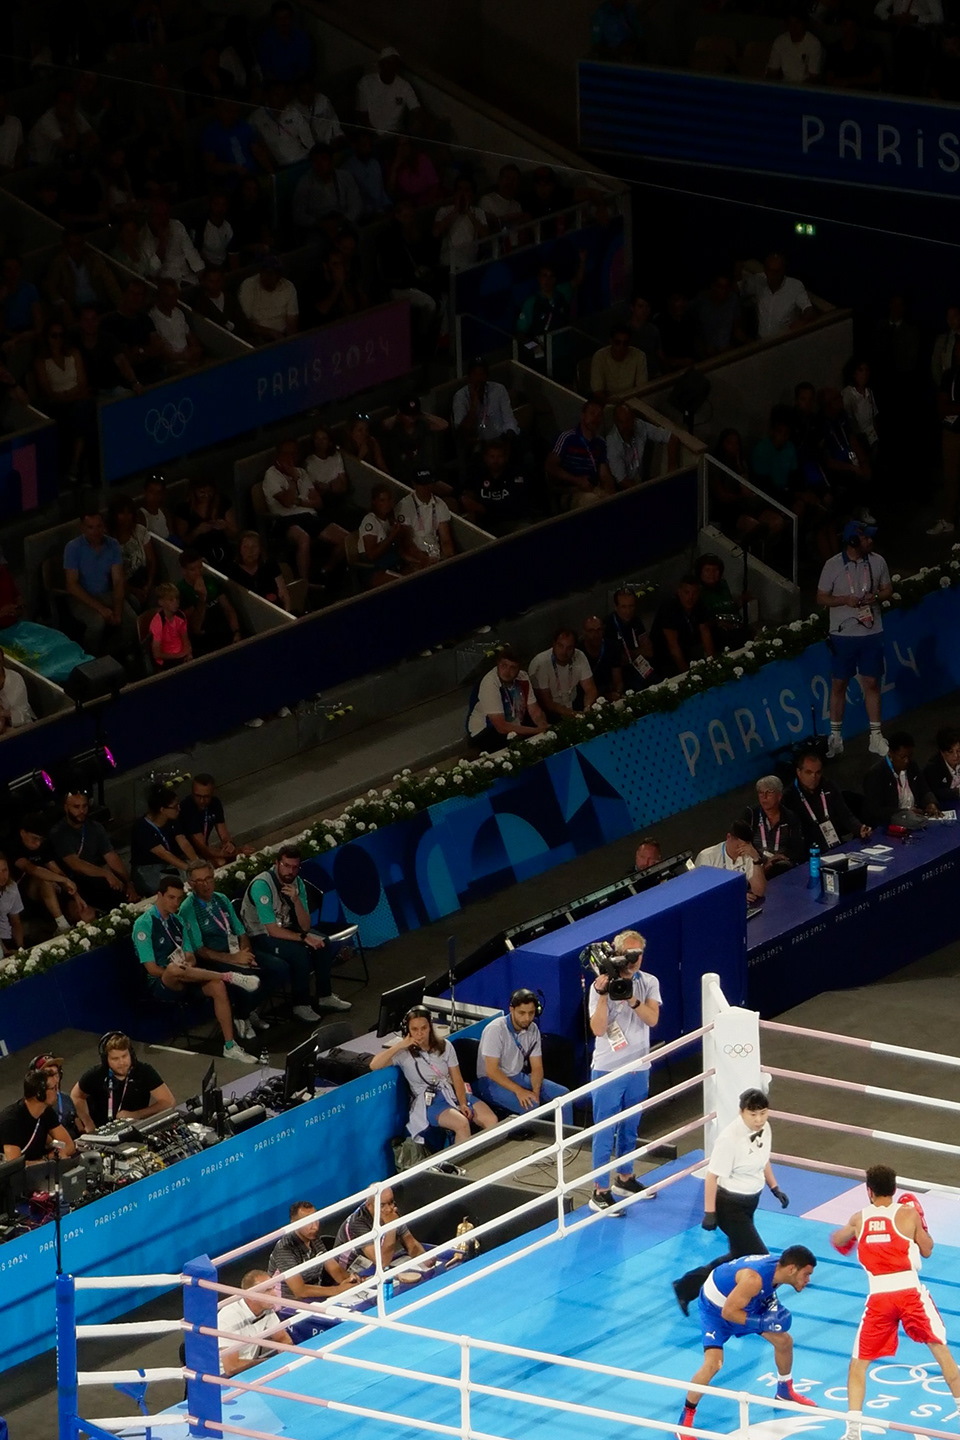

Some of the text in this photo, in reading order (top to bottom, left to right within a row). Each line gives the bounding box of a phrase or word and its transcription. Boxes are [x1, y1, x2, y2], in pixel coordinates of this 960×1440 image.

[481, 488, 510, 500] USA
[378, 1079, 397, 1094] 2024
[327, 1103, 346, 1118] 2024
[276, 1127, 296, 1142] 2024
[224, 1151, 244, 1167] 2024
[171, 1175, 191, 1191] 2024
[117, 1201, 138, 1217] 2024
[868, 1220, 886, 1231] FRA
[39, 1227, 84, 1254] PARI 2024
[8, 1253, 29, 1268] 2024
